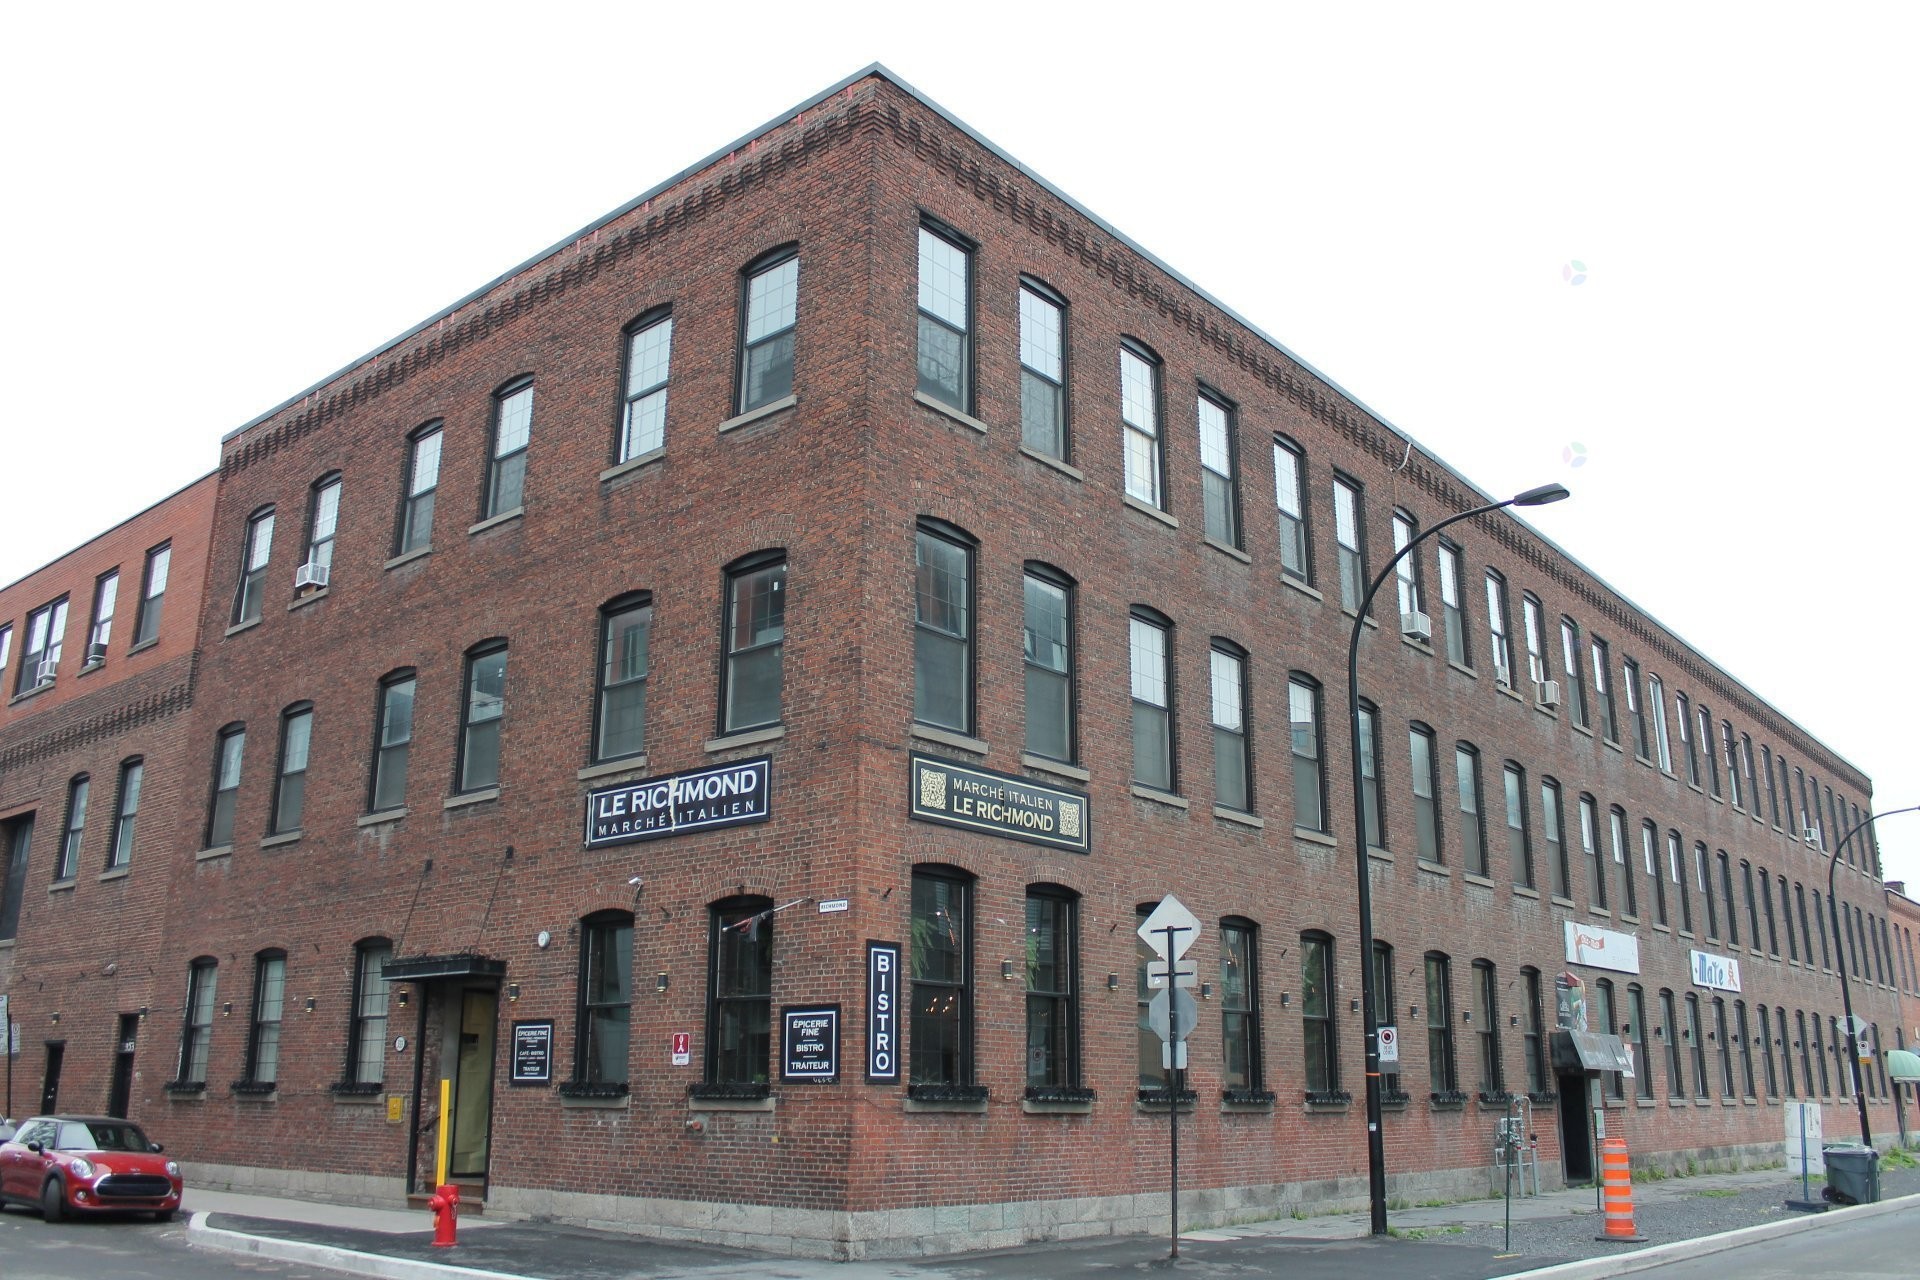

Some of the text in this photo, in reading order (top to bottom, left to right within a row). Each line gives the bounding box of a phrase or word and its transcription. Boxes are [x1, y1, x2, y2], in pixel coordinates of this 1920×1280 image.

[599, 769, 757, 819] LE RICHMOND
[953, 778, 1053, 811] MARCHÉ ITALIEN
[598, 800, 755, 836] MARCHÉ ITALIEN
[953, 795, 1054, 832] LE RICHMOND
[820, 902, 846, 910] RICHMOND
[875, 955, 890, 1070] BISTRO
[793, 1019, 829, 1029] ÉPICERIE
[801, 1028, 819, 1036] FINE
[796, 1044, 824, 1052] BISTRO
[791, 1061, 829, 1070] TRAITEUR
